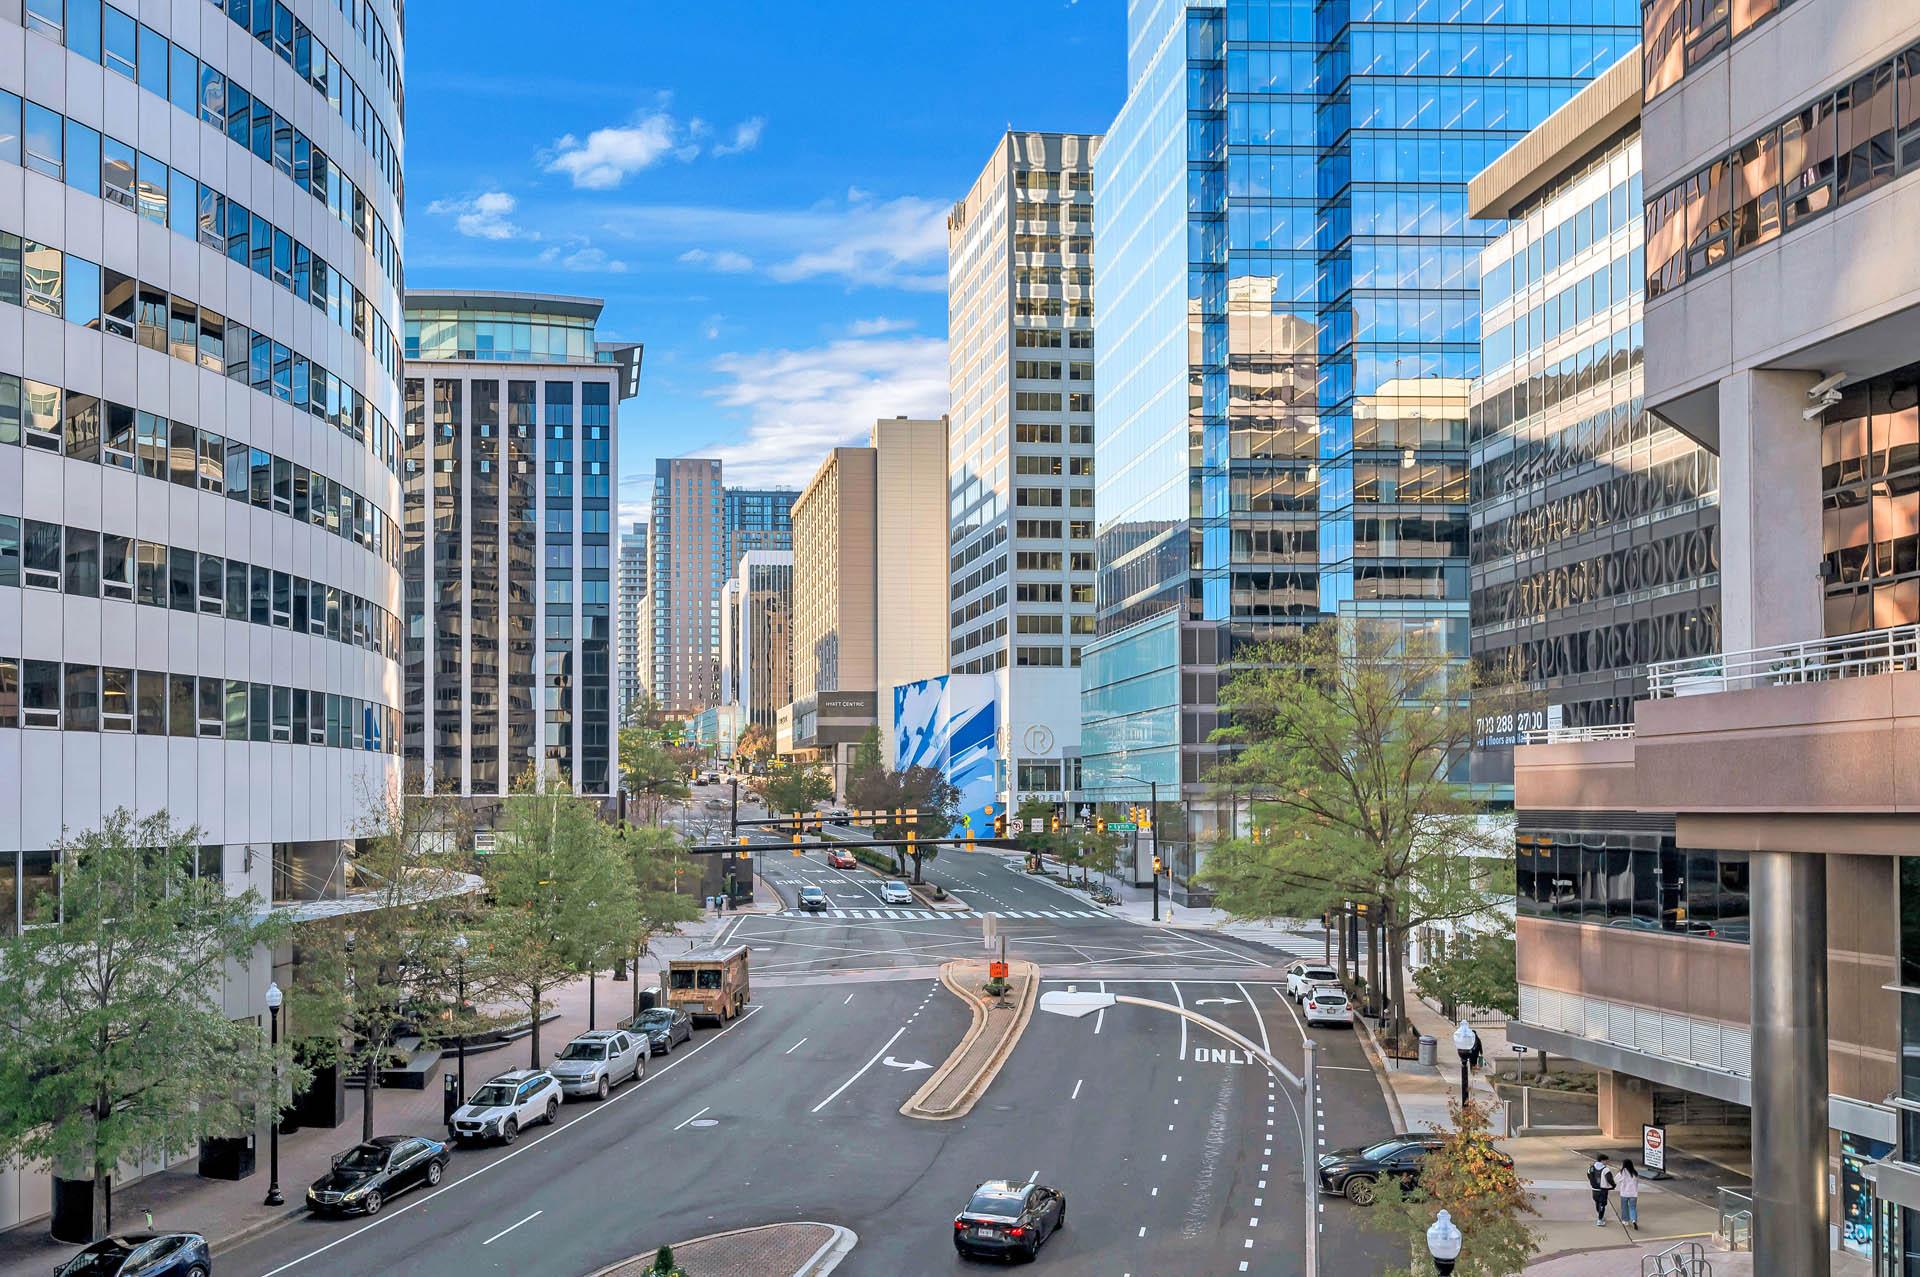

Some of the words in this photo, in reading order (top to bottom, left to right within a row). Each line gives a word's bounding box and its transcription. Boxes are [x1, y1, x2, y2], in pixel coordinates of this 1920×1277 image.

[1477, 716, 1494, 735] 703
[1496, 715, 1513, 733] 288
[1517, 711, 1542, 731] 2700
[1489, 734, 1504, 745] floors
[1113, 823, 1130, 831] Lynn
[1195, 1048, 1254, 1064] ONLY
